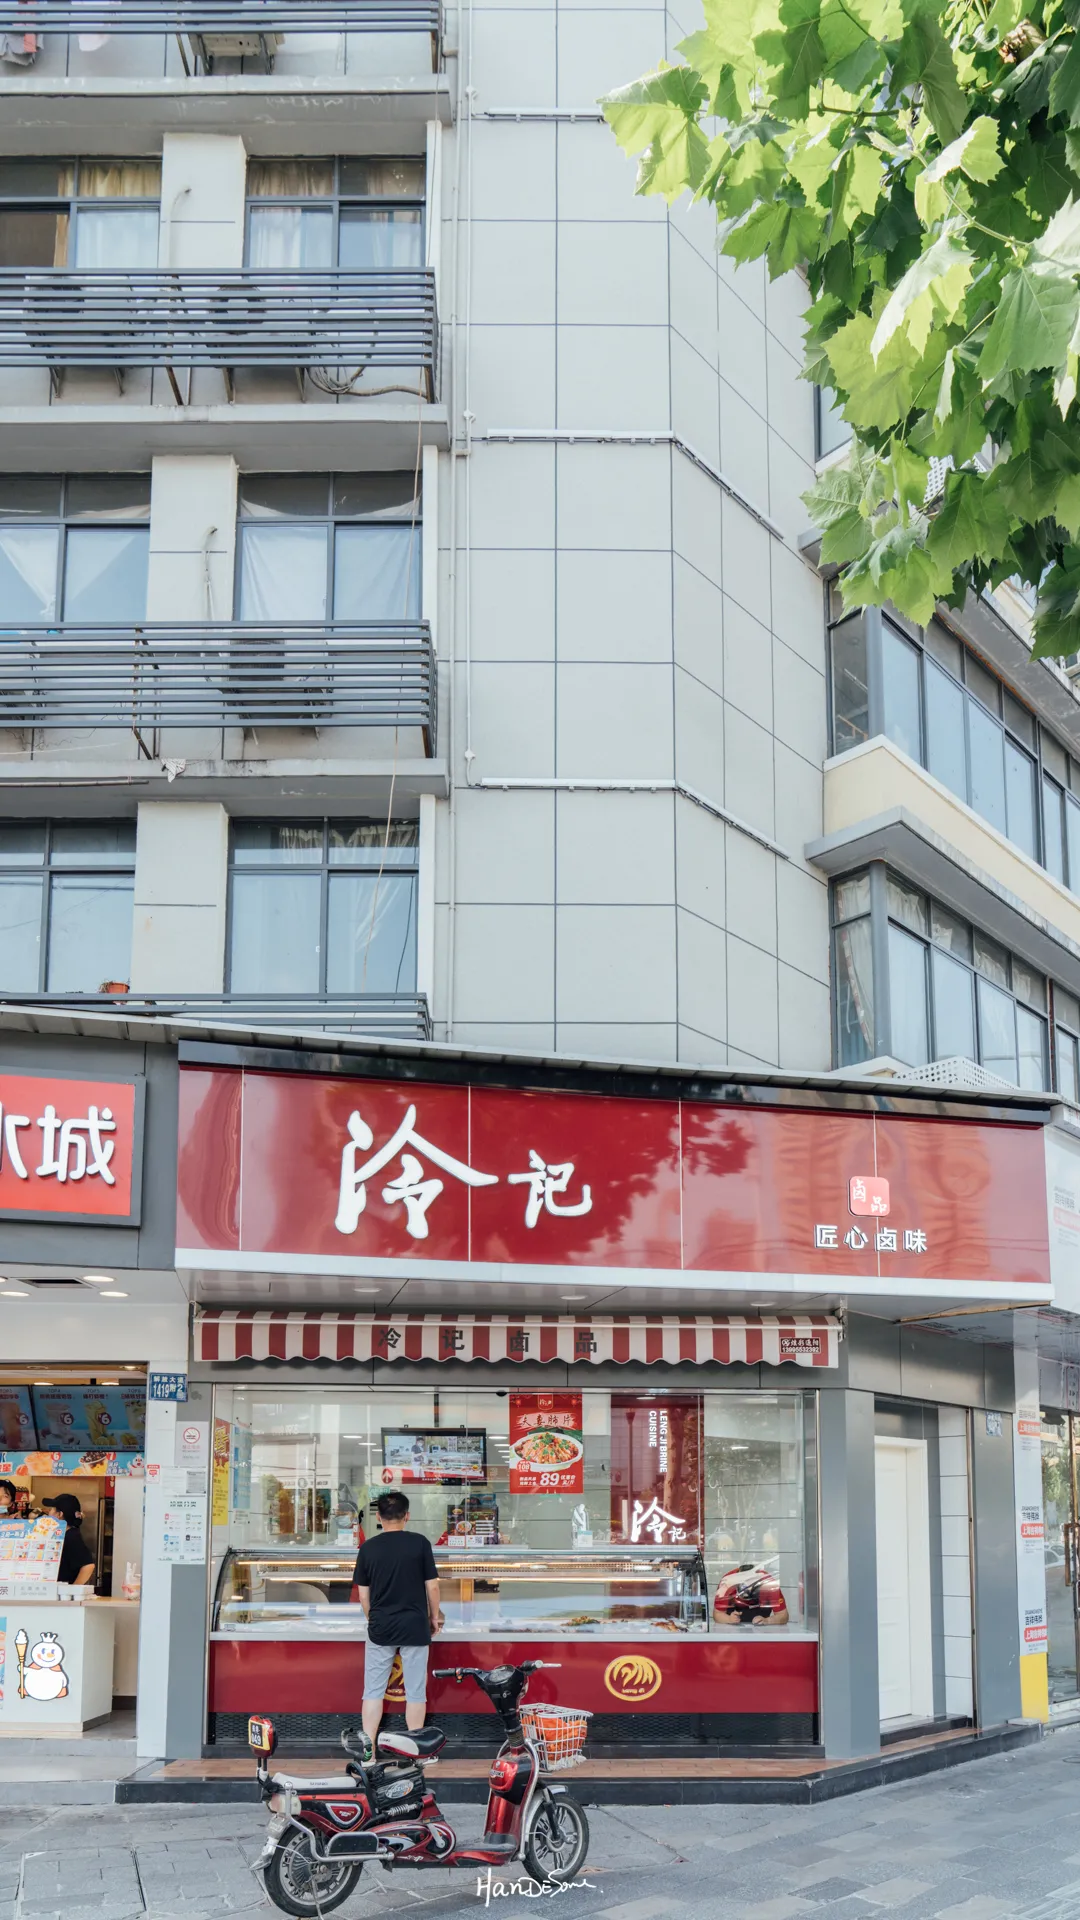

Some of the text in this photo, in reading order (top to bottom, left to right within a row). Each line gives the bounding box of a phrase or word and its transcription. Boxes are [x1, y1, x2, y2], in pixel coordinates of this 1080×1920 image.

[334, 1103, 593, 1239] 冷记
[852, 1178, 888, 1213] 卤品
[814, 1224, 927, 1253] 匠心卤味
[377, 1327, 598, 1353] 冷记卤品
[153, 1375, 184, 1383] 解放大道
[649, 1410, 657, 1447] CUISINE
[660, 1410, 668, 1434] LENG
[660, 1446, 668, 1473] BRINE
[540, 1473, 560, 1486] 89
[631, 1497, 686, 1543] 冷记
